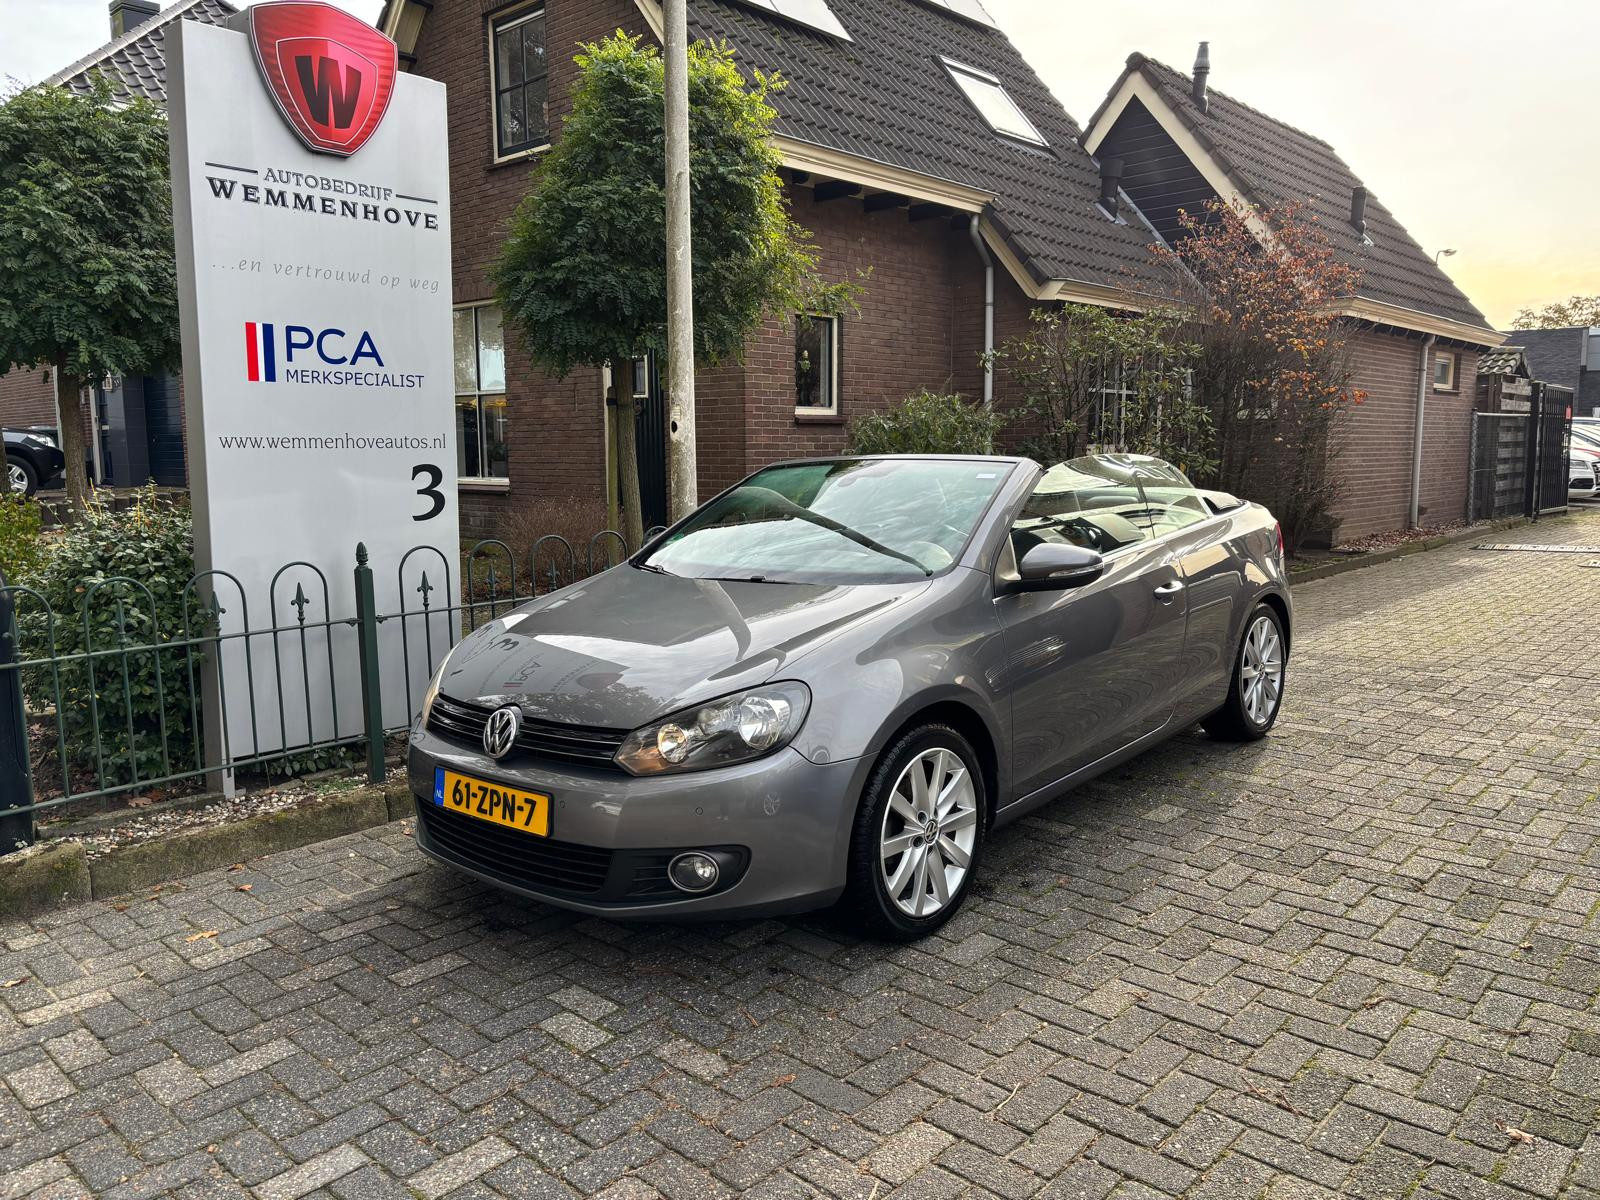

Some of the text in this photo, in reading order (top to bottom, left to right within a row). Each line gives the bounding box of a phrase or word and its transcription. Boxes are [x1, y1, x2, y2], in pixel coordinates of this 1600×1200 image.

[294, 55, 362, 129] W
[205, 175, 439, 231] WEMMENHOVE
[263, 167, 394, 201] AUTOBEDRIJF
[273, 263, 371, 285] vertrouwd
[380, 274, 400, 288] op
[409, 278, 440, 294] weg
[285, 325, 385, 367] PCA
[286, 368, 425, 388] MERKSPECIALIST
[218, 432, 447, 450] www.wemmenhoveautos.nl
[411, 463, 446, 521] 3
[435, 789, 443, 799] NL
[452, 779, 537, 827] 61-ZPN-7
